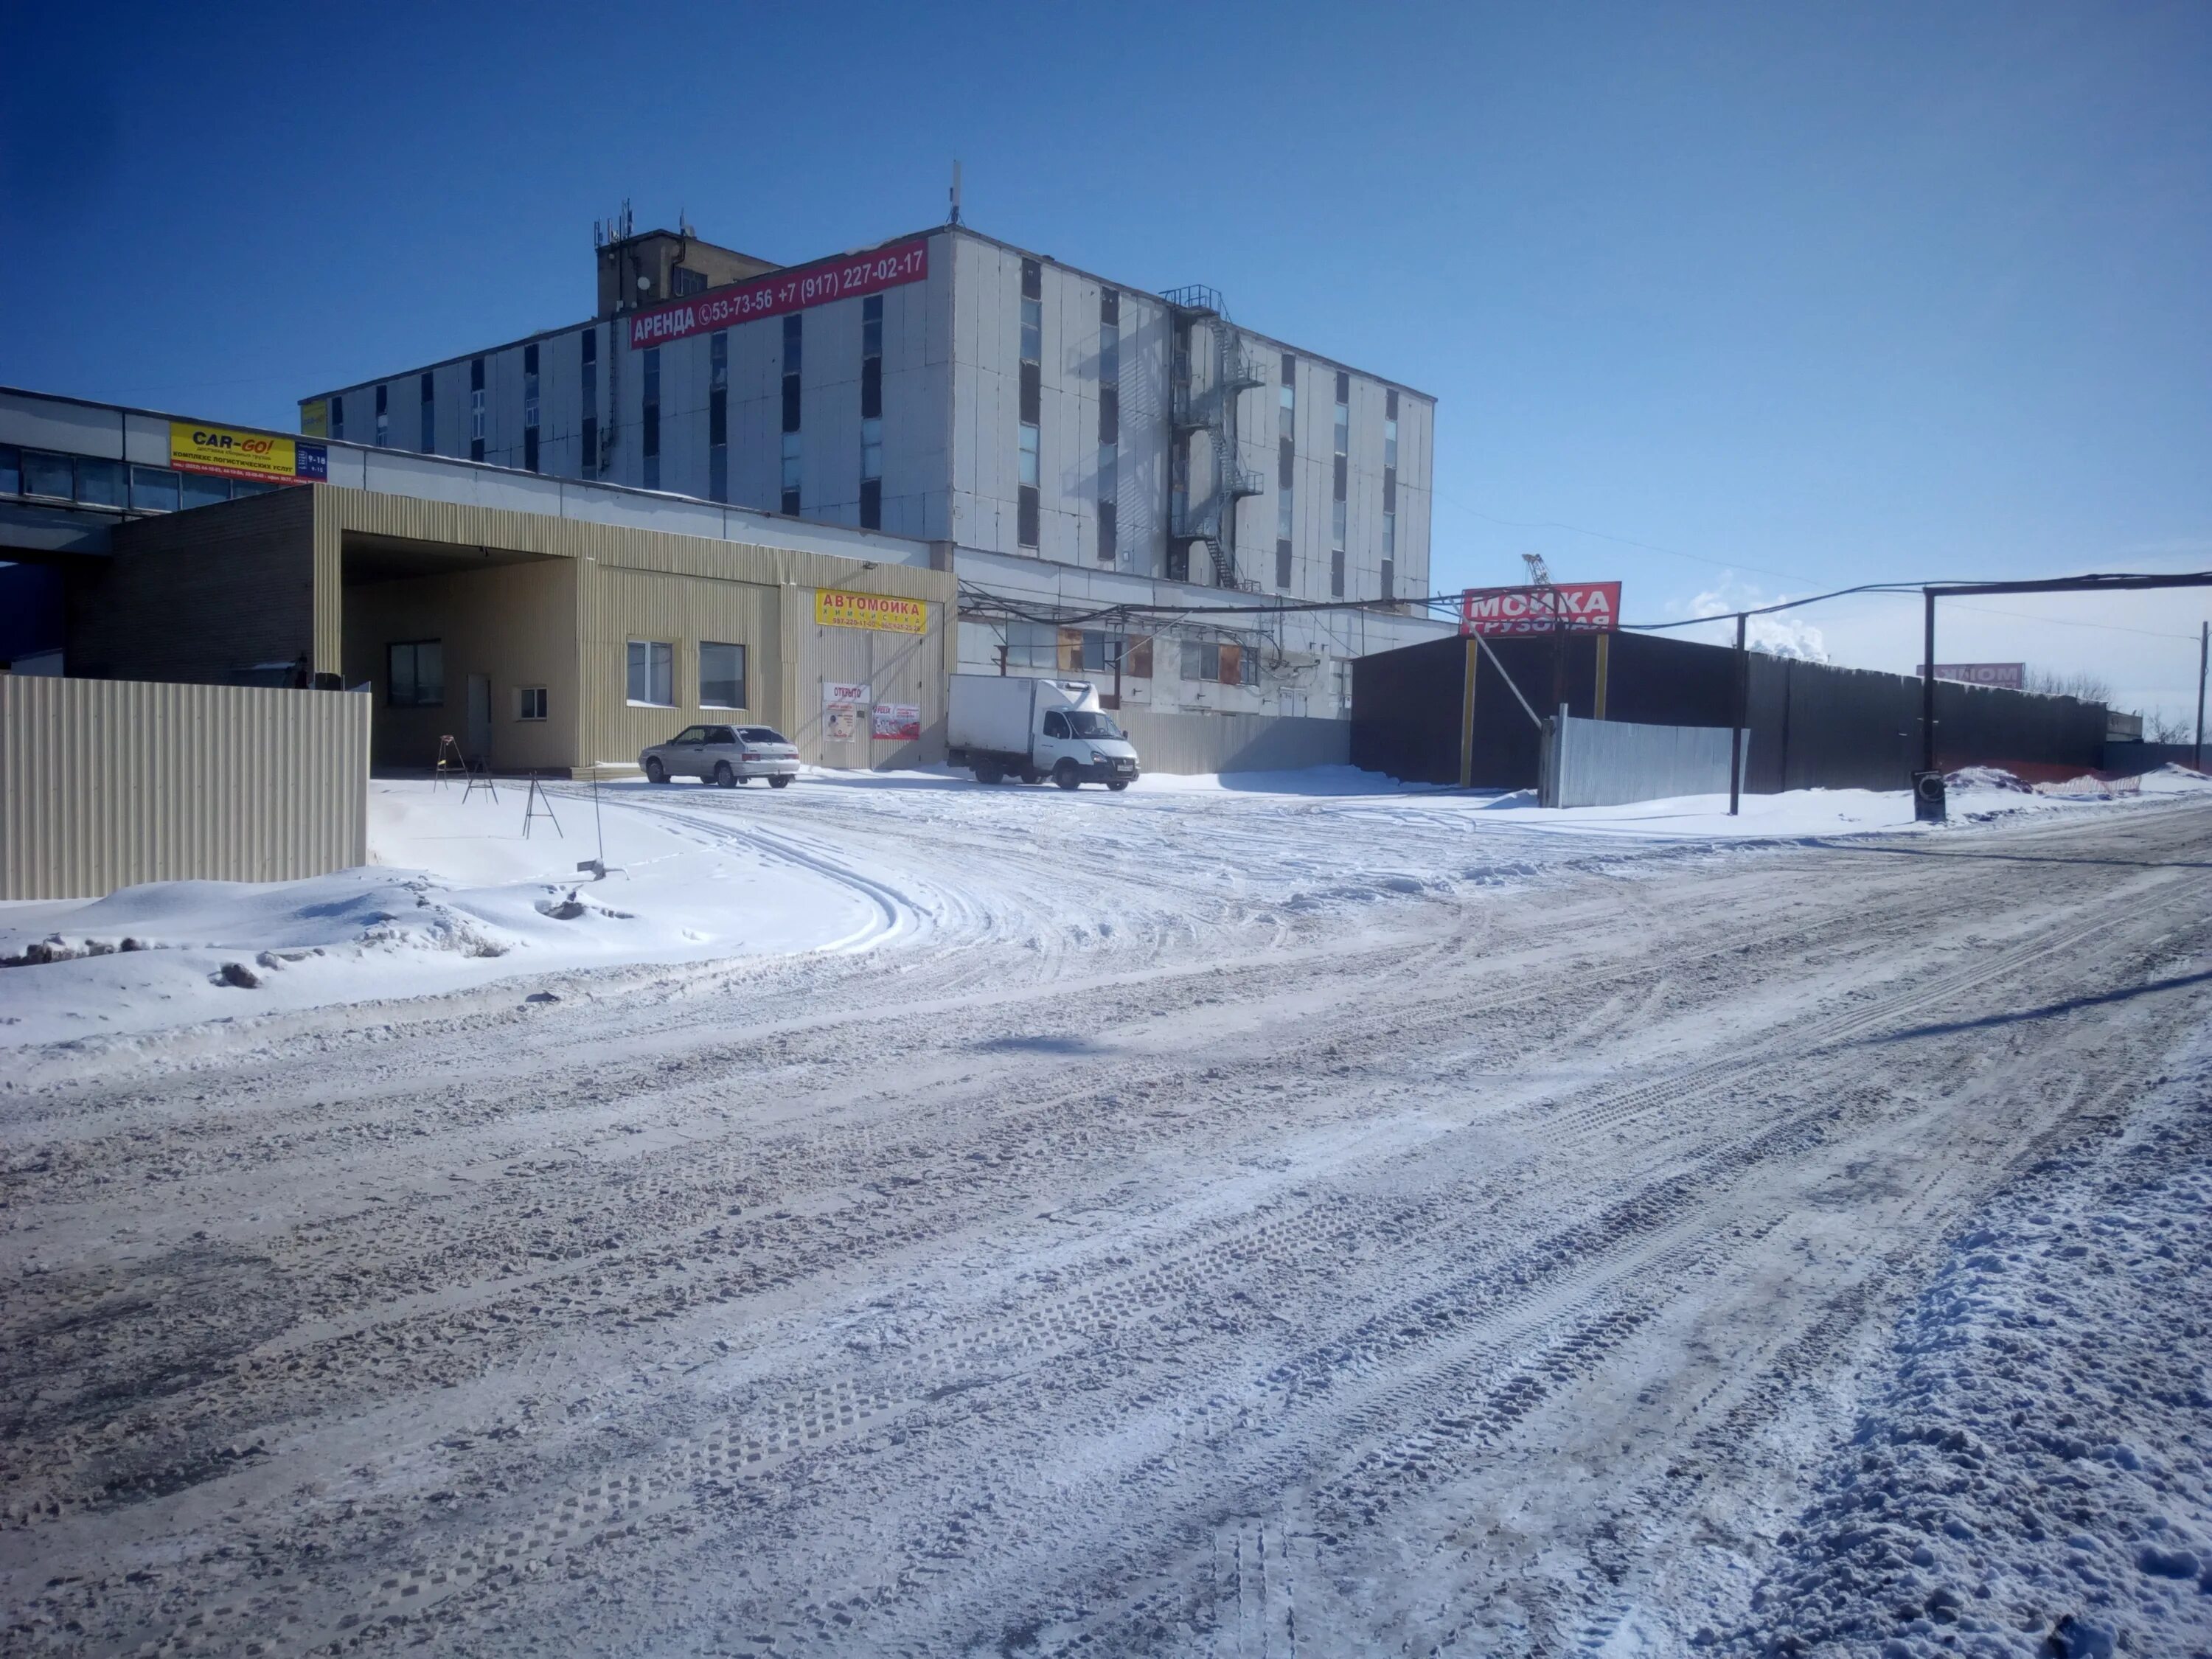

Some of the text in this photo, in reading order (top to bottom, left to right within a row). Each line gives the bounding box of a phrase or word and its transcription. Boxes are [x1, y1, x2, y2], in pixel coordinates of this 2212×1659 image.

[634, 250, 923, 341] АРЕНДА 53-73-56 +7 (917) 227-02-17
[193, 431, 274, 454] CAR-GO!
[173, 451, 212, 461] КОМПЛЕКС
[213, 456, 271, 470] ЛОГИСТИЧЕСКИХ
[1470, 588, 1610, 617] МОЙКА
[834, 687, 861, 698] ОТКРЫТО
